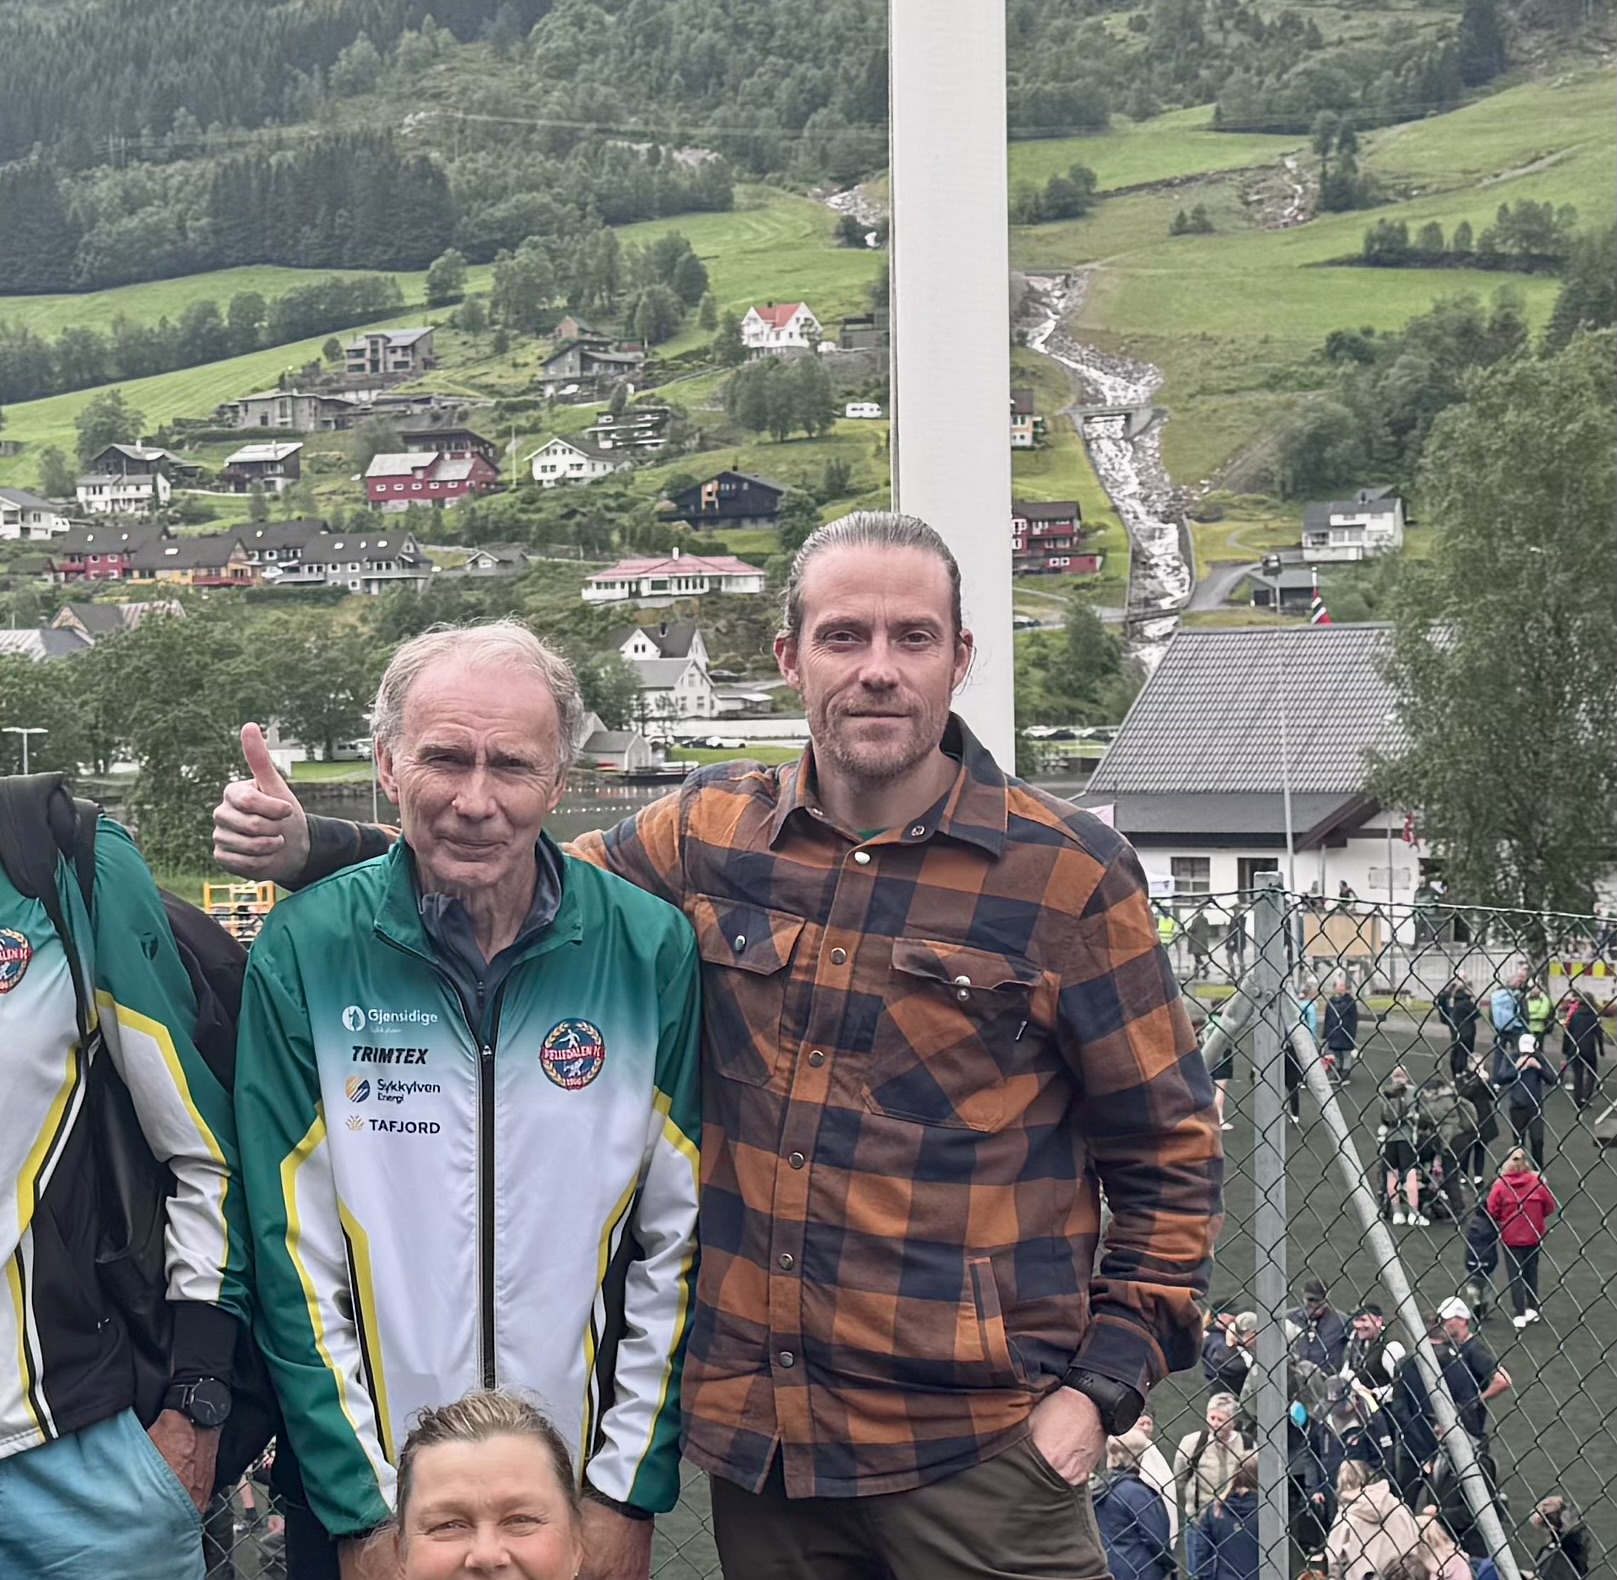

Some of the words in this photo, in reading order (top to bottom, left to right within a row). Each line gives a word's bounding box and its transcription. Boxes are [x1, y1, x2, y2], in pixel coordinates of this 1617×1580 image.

[368, 1009, 438, 1026] Gjensidige
[352, 1046, 428, 1065] TRIMTEX
[377, 1078, 441, 1095] Sykkylven
[369, 1119, 441, 1134] TAFJORD
